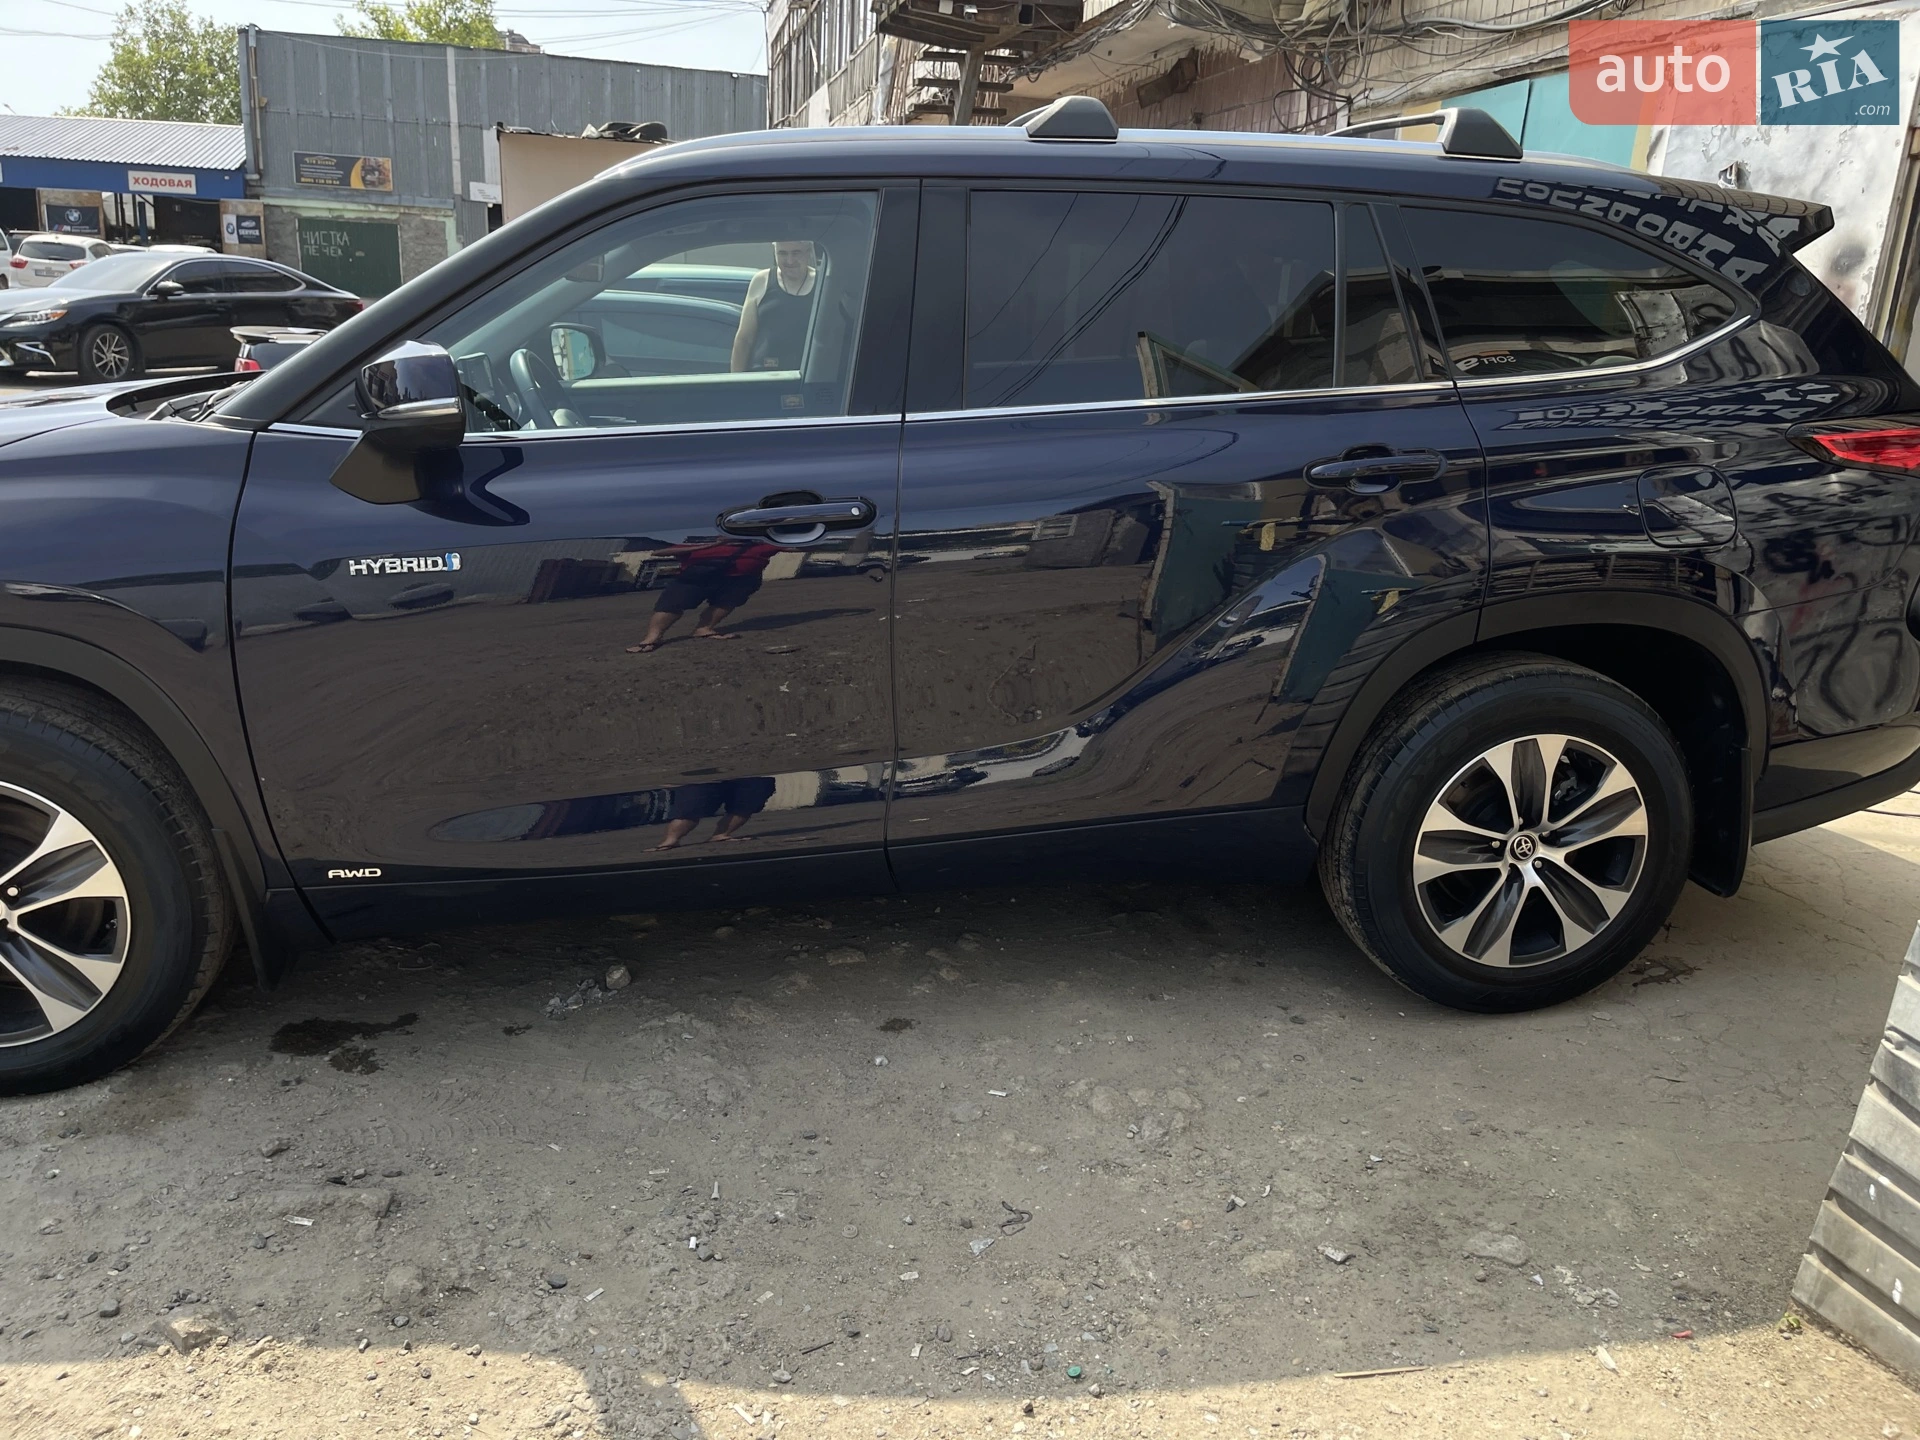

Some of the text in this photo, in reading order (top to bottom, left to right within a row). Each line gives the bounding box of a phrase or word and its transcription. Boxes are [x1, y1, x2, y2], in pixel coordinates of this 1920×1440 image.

[133, 176, 193, 188] ХОДОВАЯ
[302, 231, 350, 246] ЧИСТКА
[349, 555, 443, 576] HYBRID
[327, 867, 382, 879] AWD
